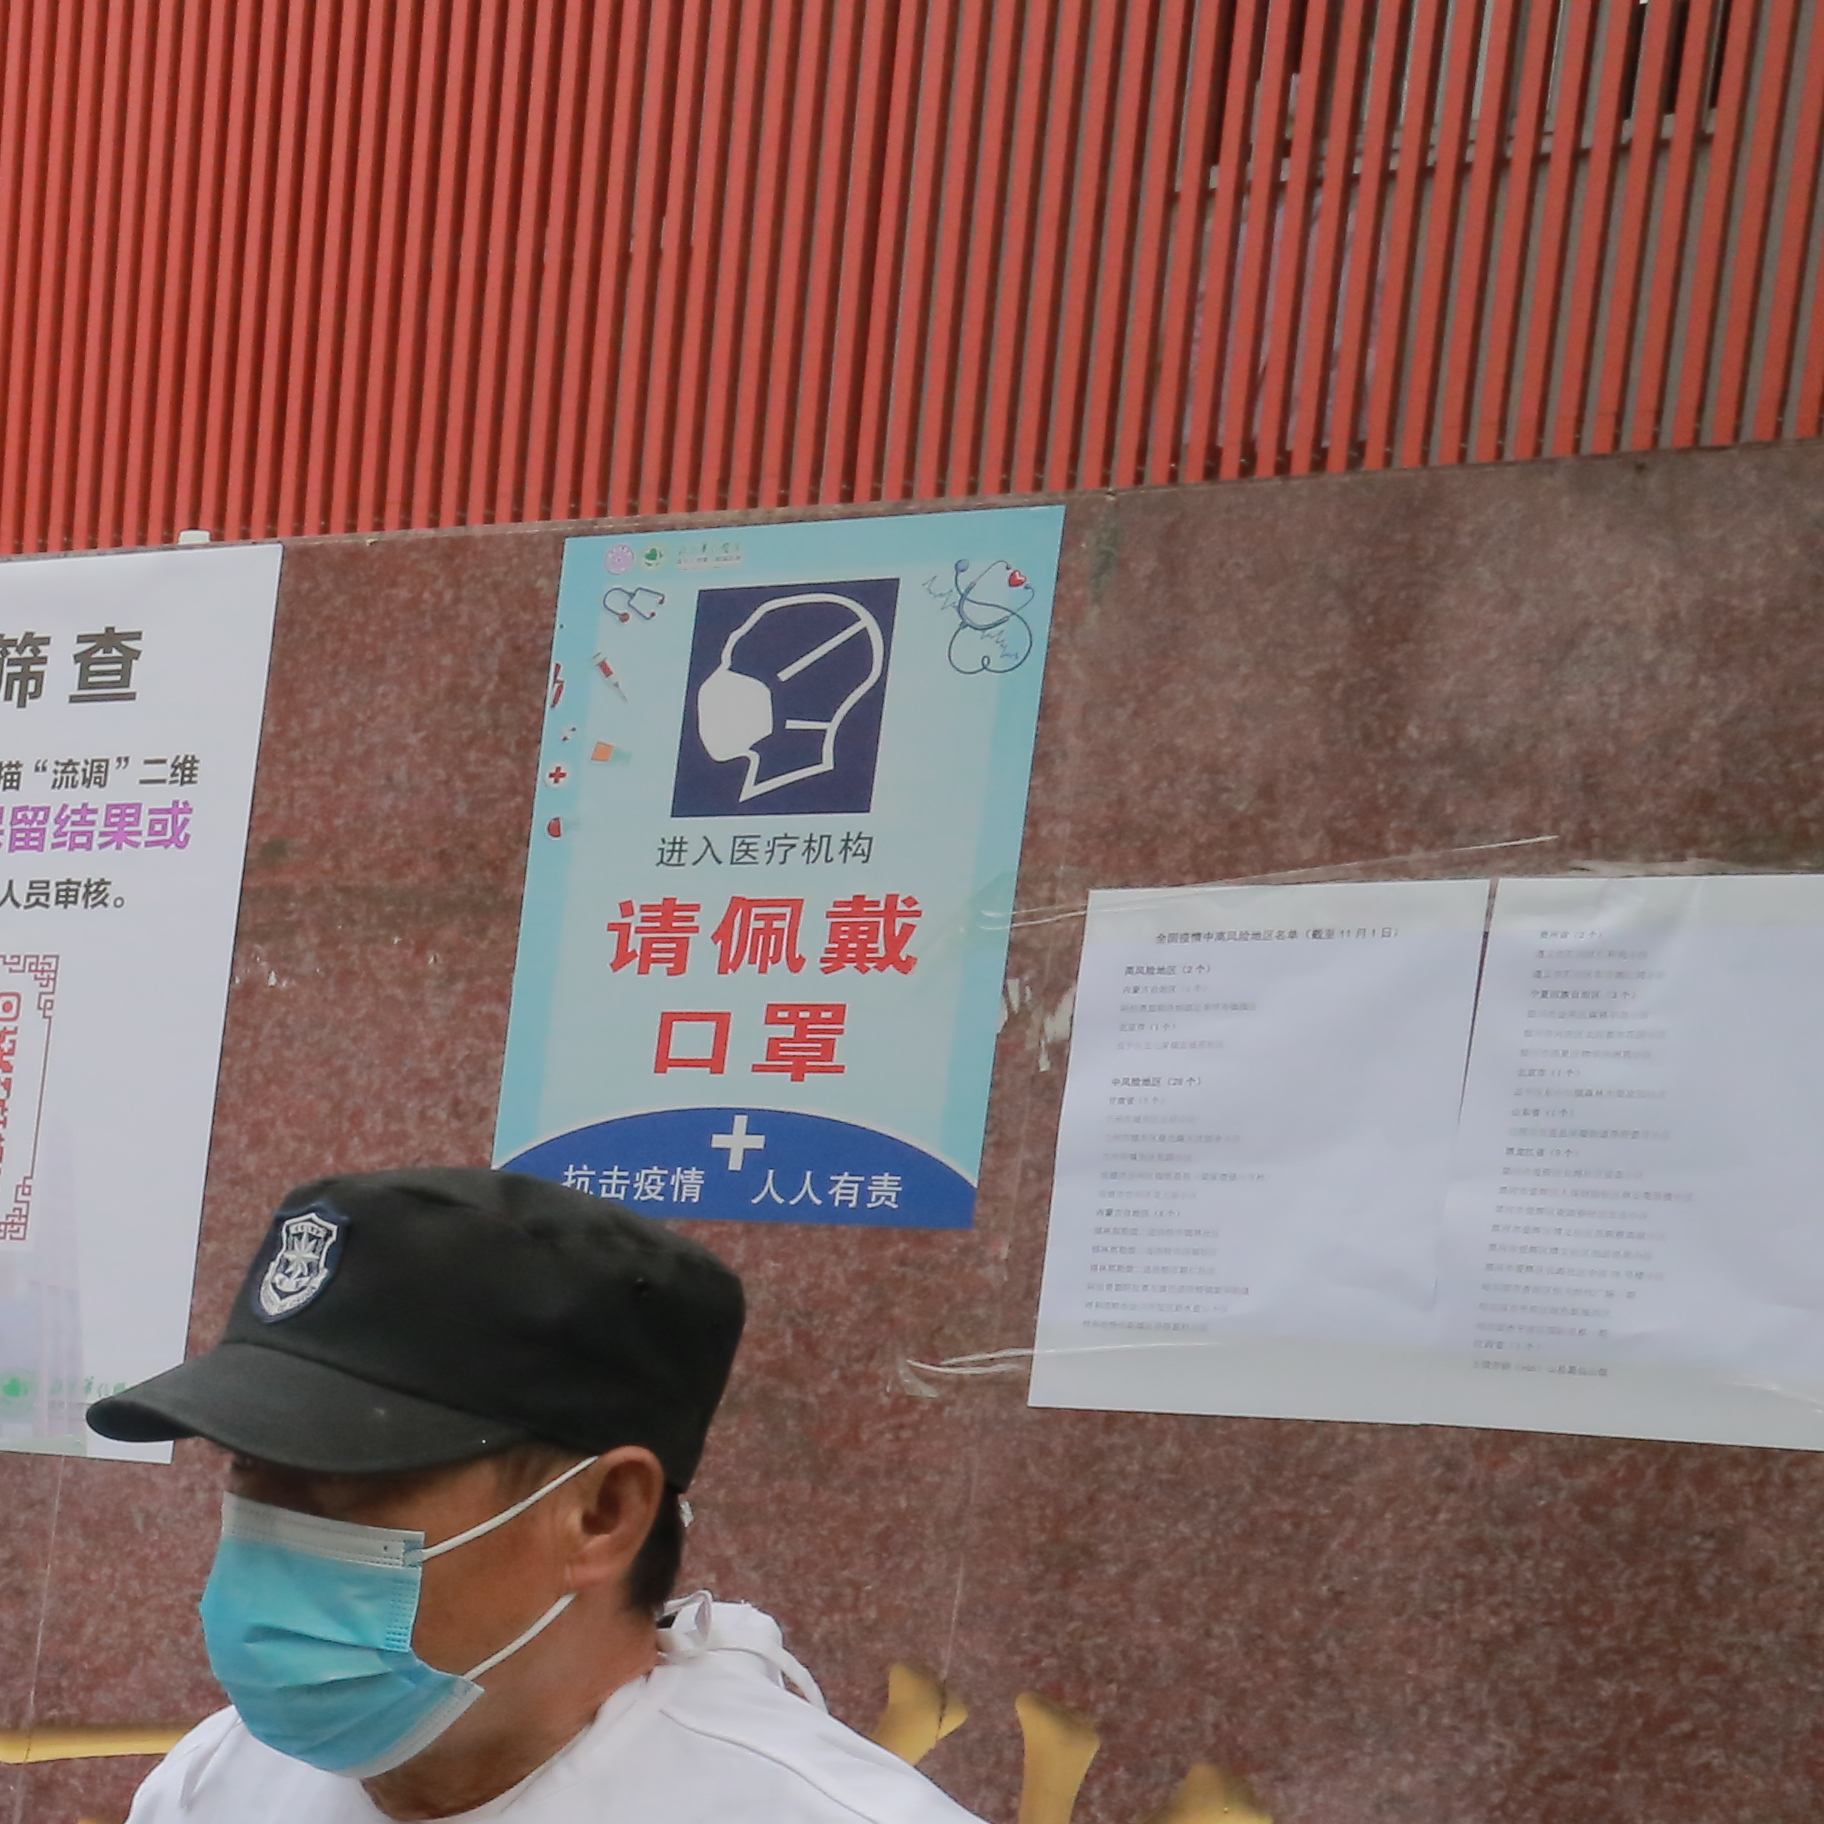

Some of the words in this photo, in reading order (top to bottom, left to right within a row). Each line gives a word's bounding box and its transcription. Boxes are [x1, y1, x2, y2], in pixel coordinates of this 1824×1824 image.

[655, 834, 873, 868] 进入医疗机构
[607, 894, 924, 978] 请佩戴
[654, 1002, 849, 1082] 口罩
[561, 1164, 706, 1203] 抗击疫情
[751, 1169, 903, 1209] 人人有责
